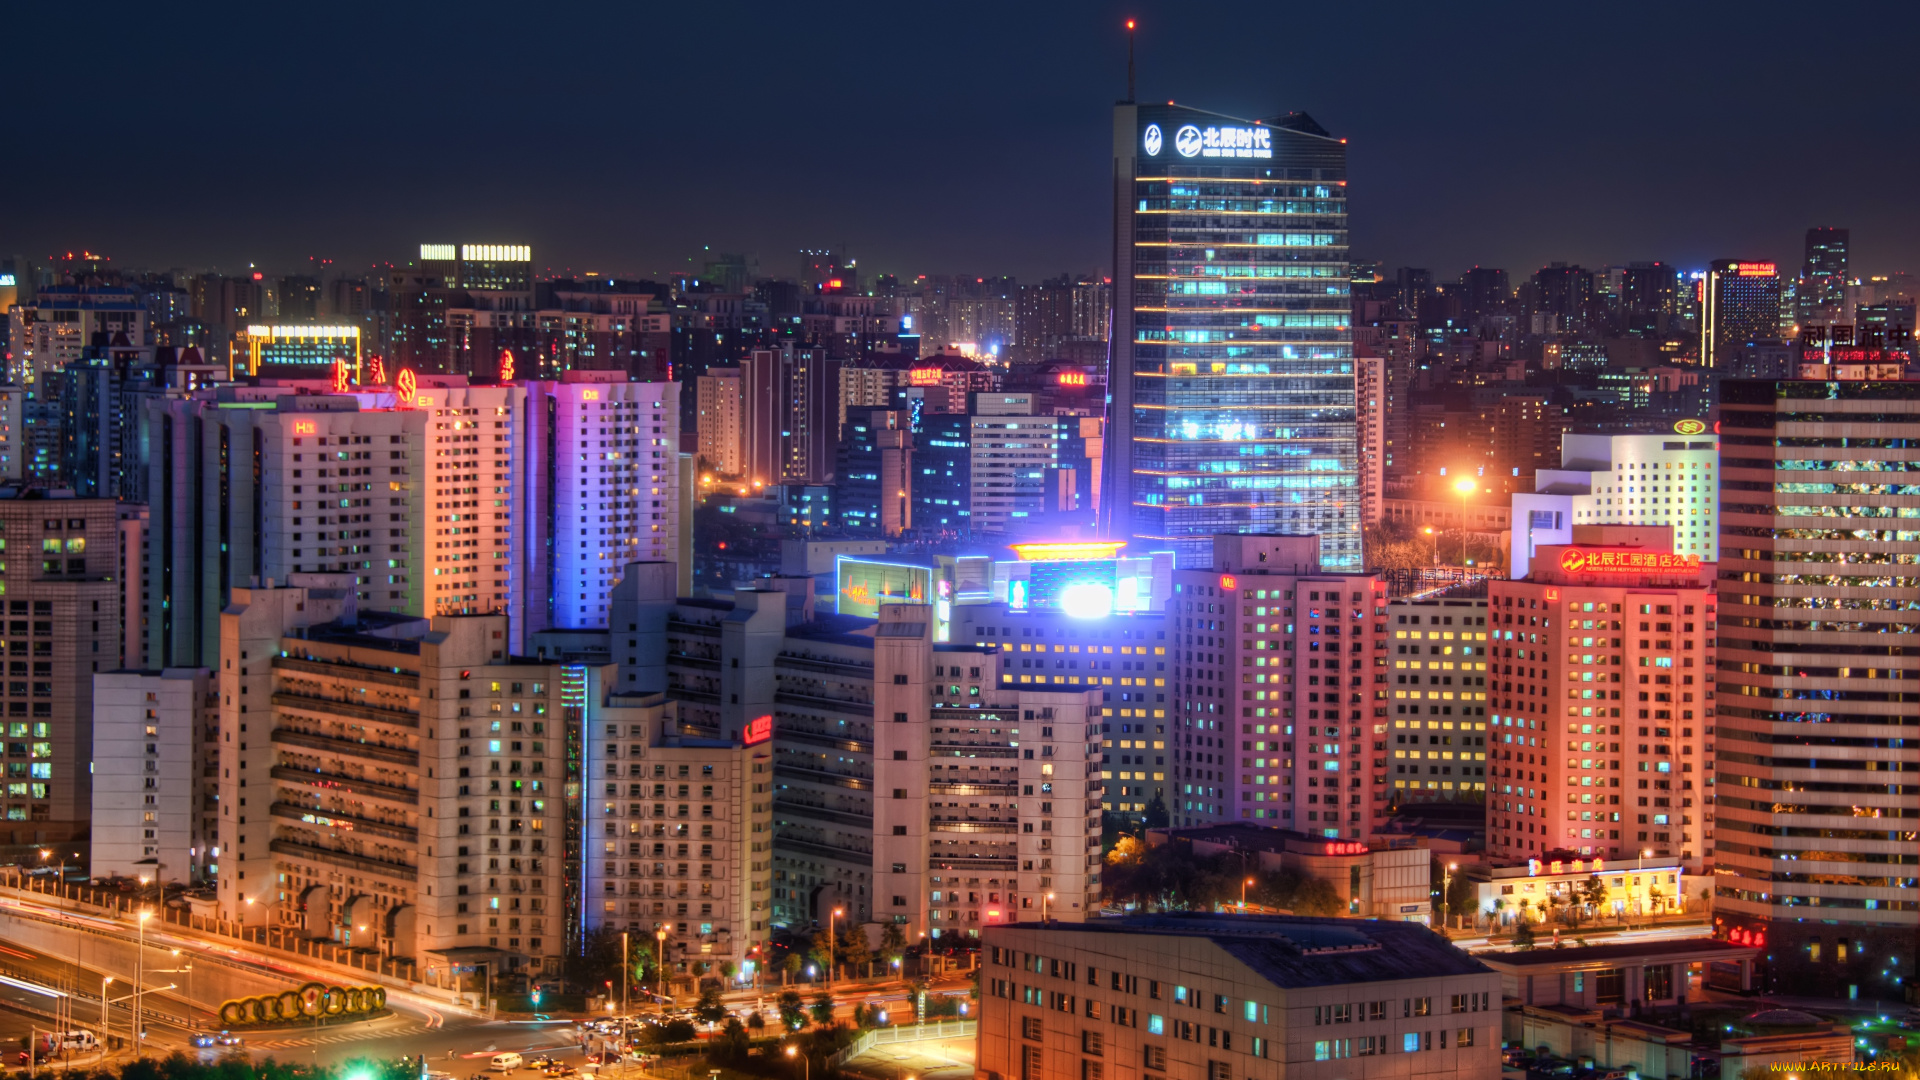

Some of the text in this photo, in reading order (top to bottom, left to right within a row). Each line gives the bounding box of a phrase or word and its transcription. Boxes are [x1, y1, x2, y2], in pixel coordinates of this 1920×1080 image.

[1203, 127, 1270, 149] 北辰时代
[1586, 552, 1700, 568] 北辰汇园酒店公寓
